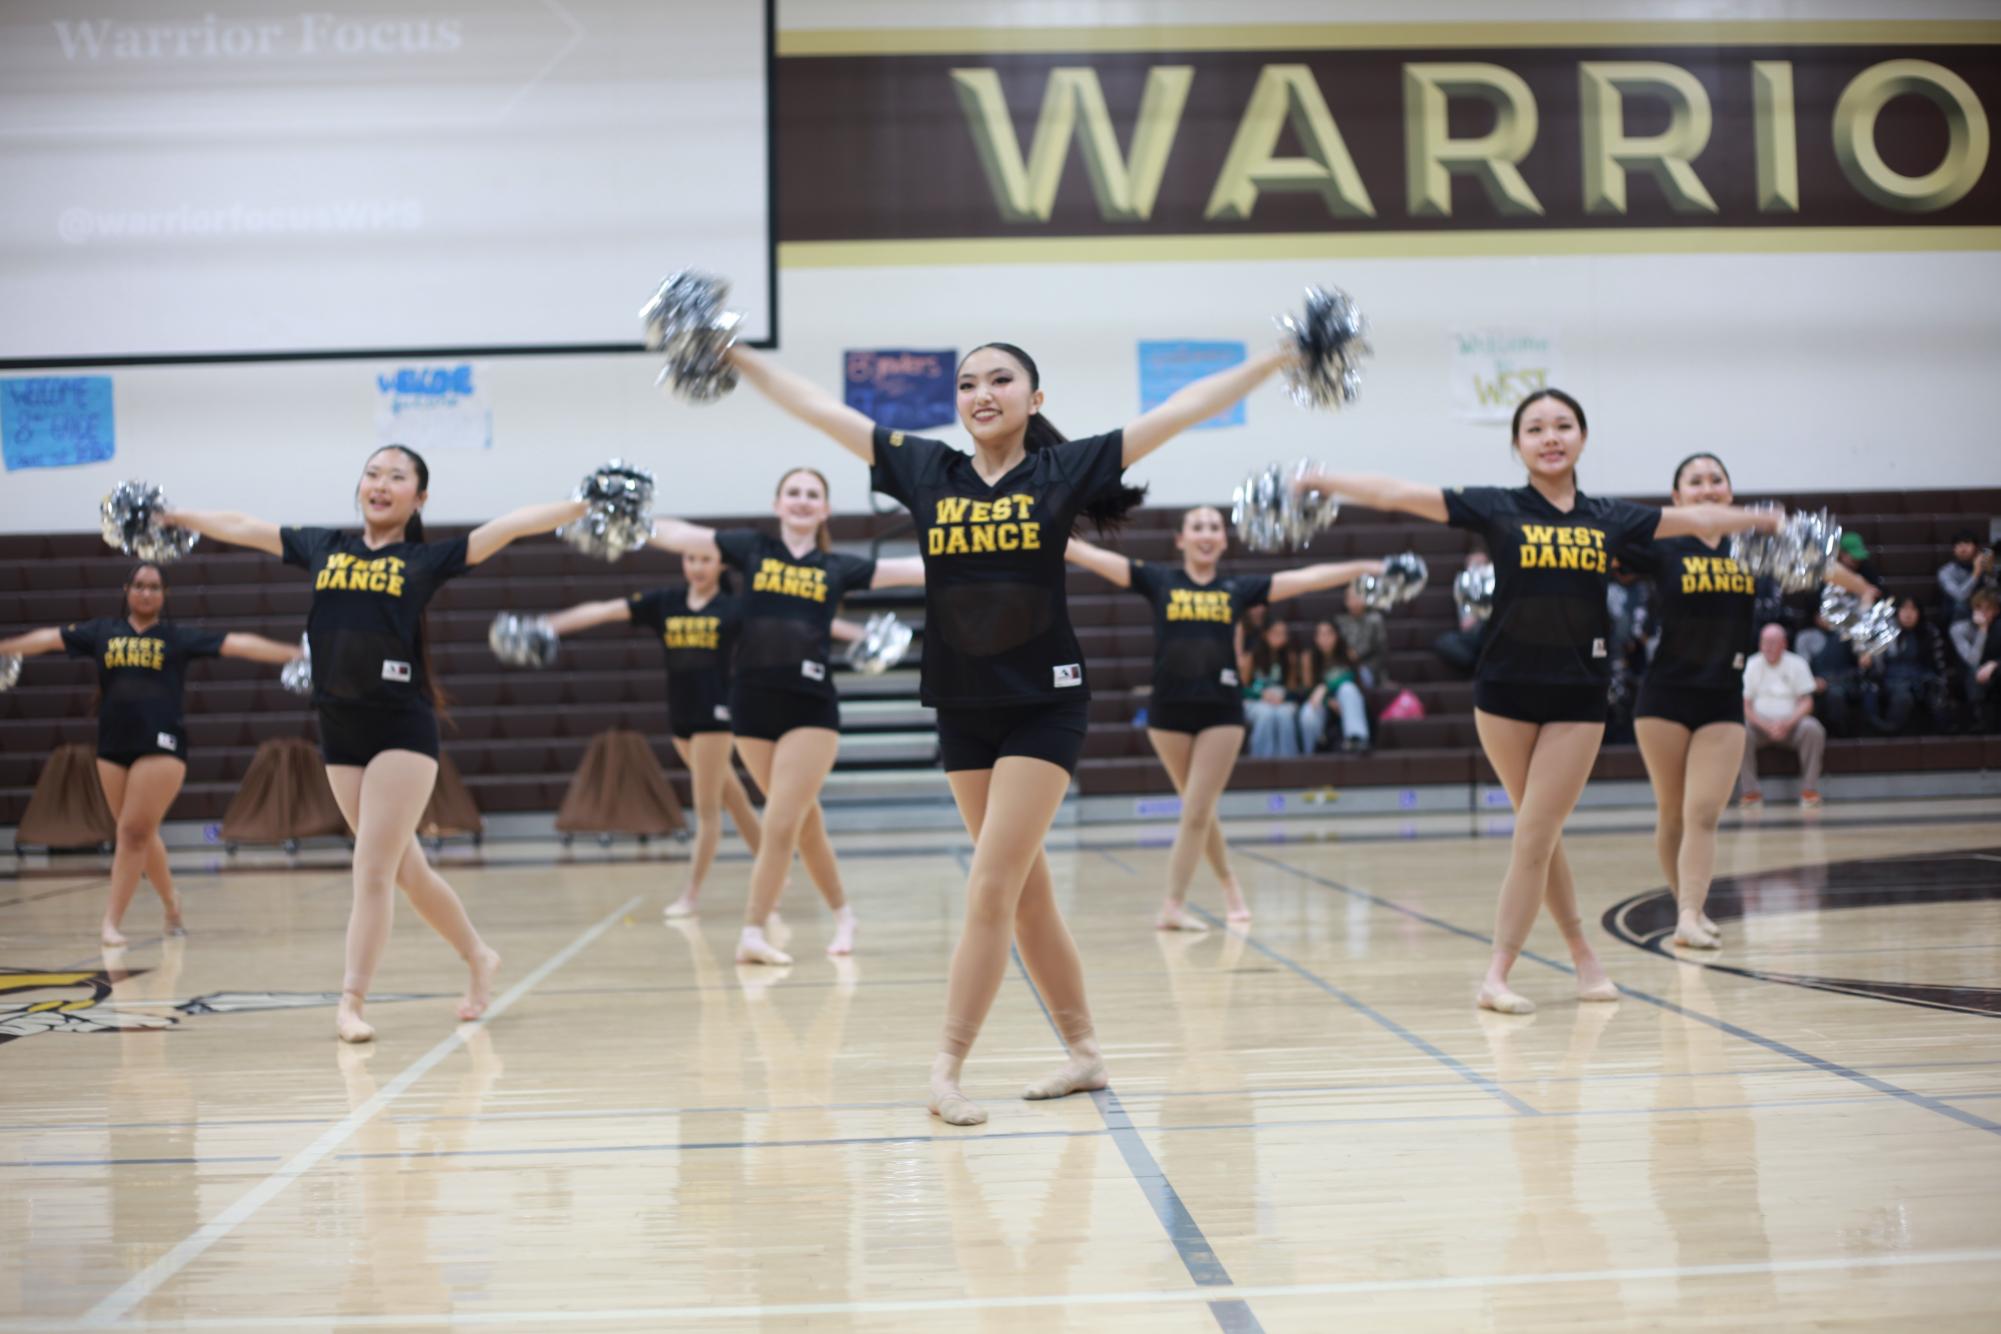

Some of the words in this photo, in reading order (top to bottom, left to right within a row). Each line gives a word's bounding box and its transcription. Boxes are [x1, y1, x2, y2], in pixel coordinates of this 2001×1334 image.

[54, 13, 283, 60] Warrior
[300, 13, 463, 55] Focus
[950, 58, 1990, 222] WARRIO
[936, 494, 1035, 524] WEST
[928, 522, 1041, 556] DANCE
[1521, 525, 1605, 548] WEST
[327, 552, 406, 574] WEST
[761, 558, 827, 583] WEST
[1520, 545, 1606, 574] DANCE
[315, 568, 405, 598] DANCE
[752, 571, 828, 603] DANCE
[107, 636, 166, 651] WEST
[103, 650, 165, 671] DANCE
